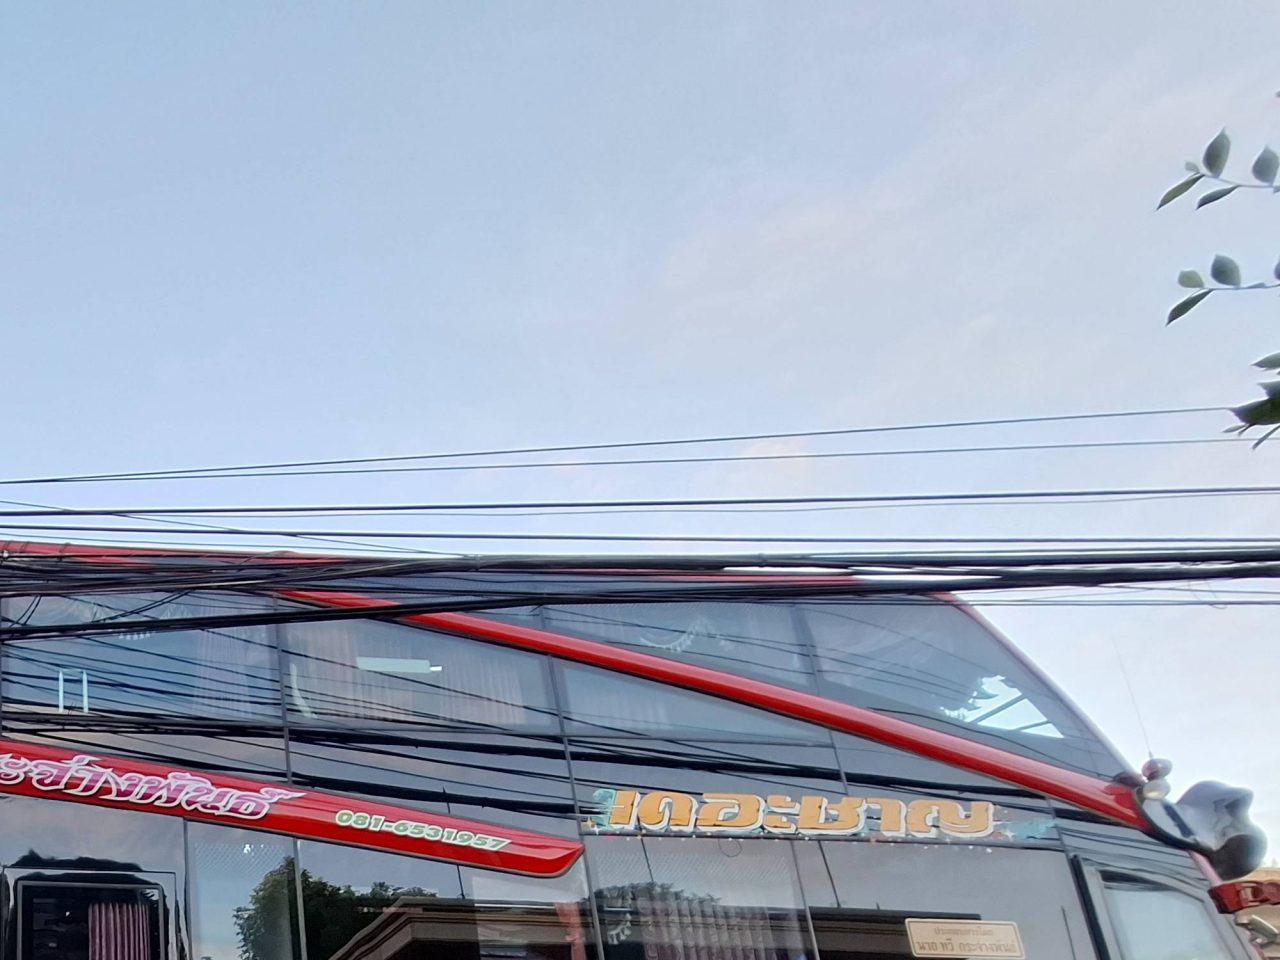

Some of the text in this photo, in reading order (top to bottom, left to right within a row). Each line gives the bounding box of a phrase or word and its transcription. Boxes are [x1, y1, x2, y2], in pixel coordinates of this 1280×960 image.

[335, 809, 512, 851] 081-6531957
[605, 789, 997, 838] เดอะชาญ
